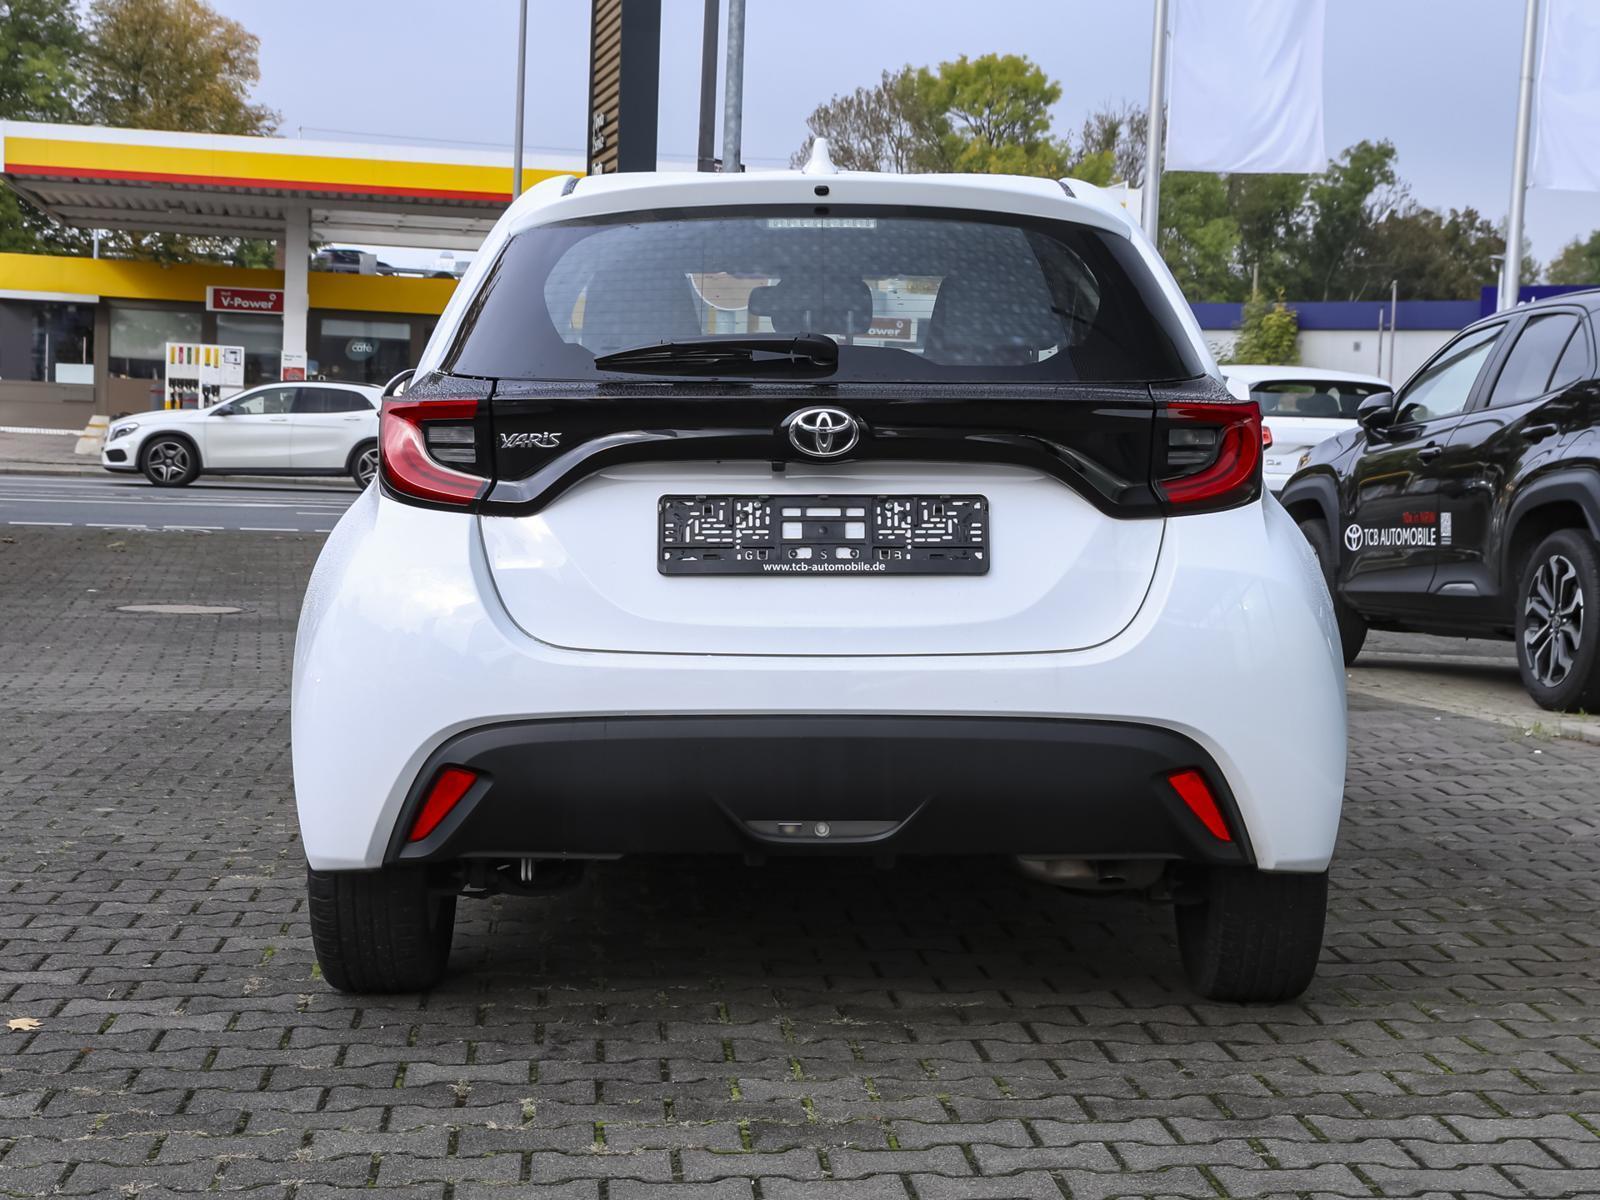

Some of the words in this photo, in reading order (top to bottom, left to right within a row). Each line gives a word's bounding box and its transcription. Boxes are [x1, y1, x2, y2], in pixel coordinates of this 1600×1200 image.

[221, 296, 274, 309] V-Power
[1363, 528, 1379, 546] TCB
[1379, 527, 1437, 546] AUTOMOBILE
[763, 561, 886, 571] www.tcb-automobile.de
